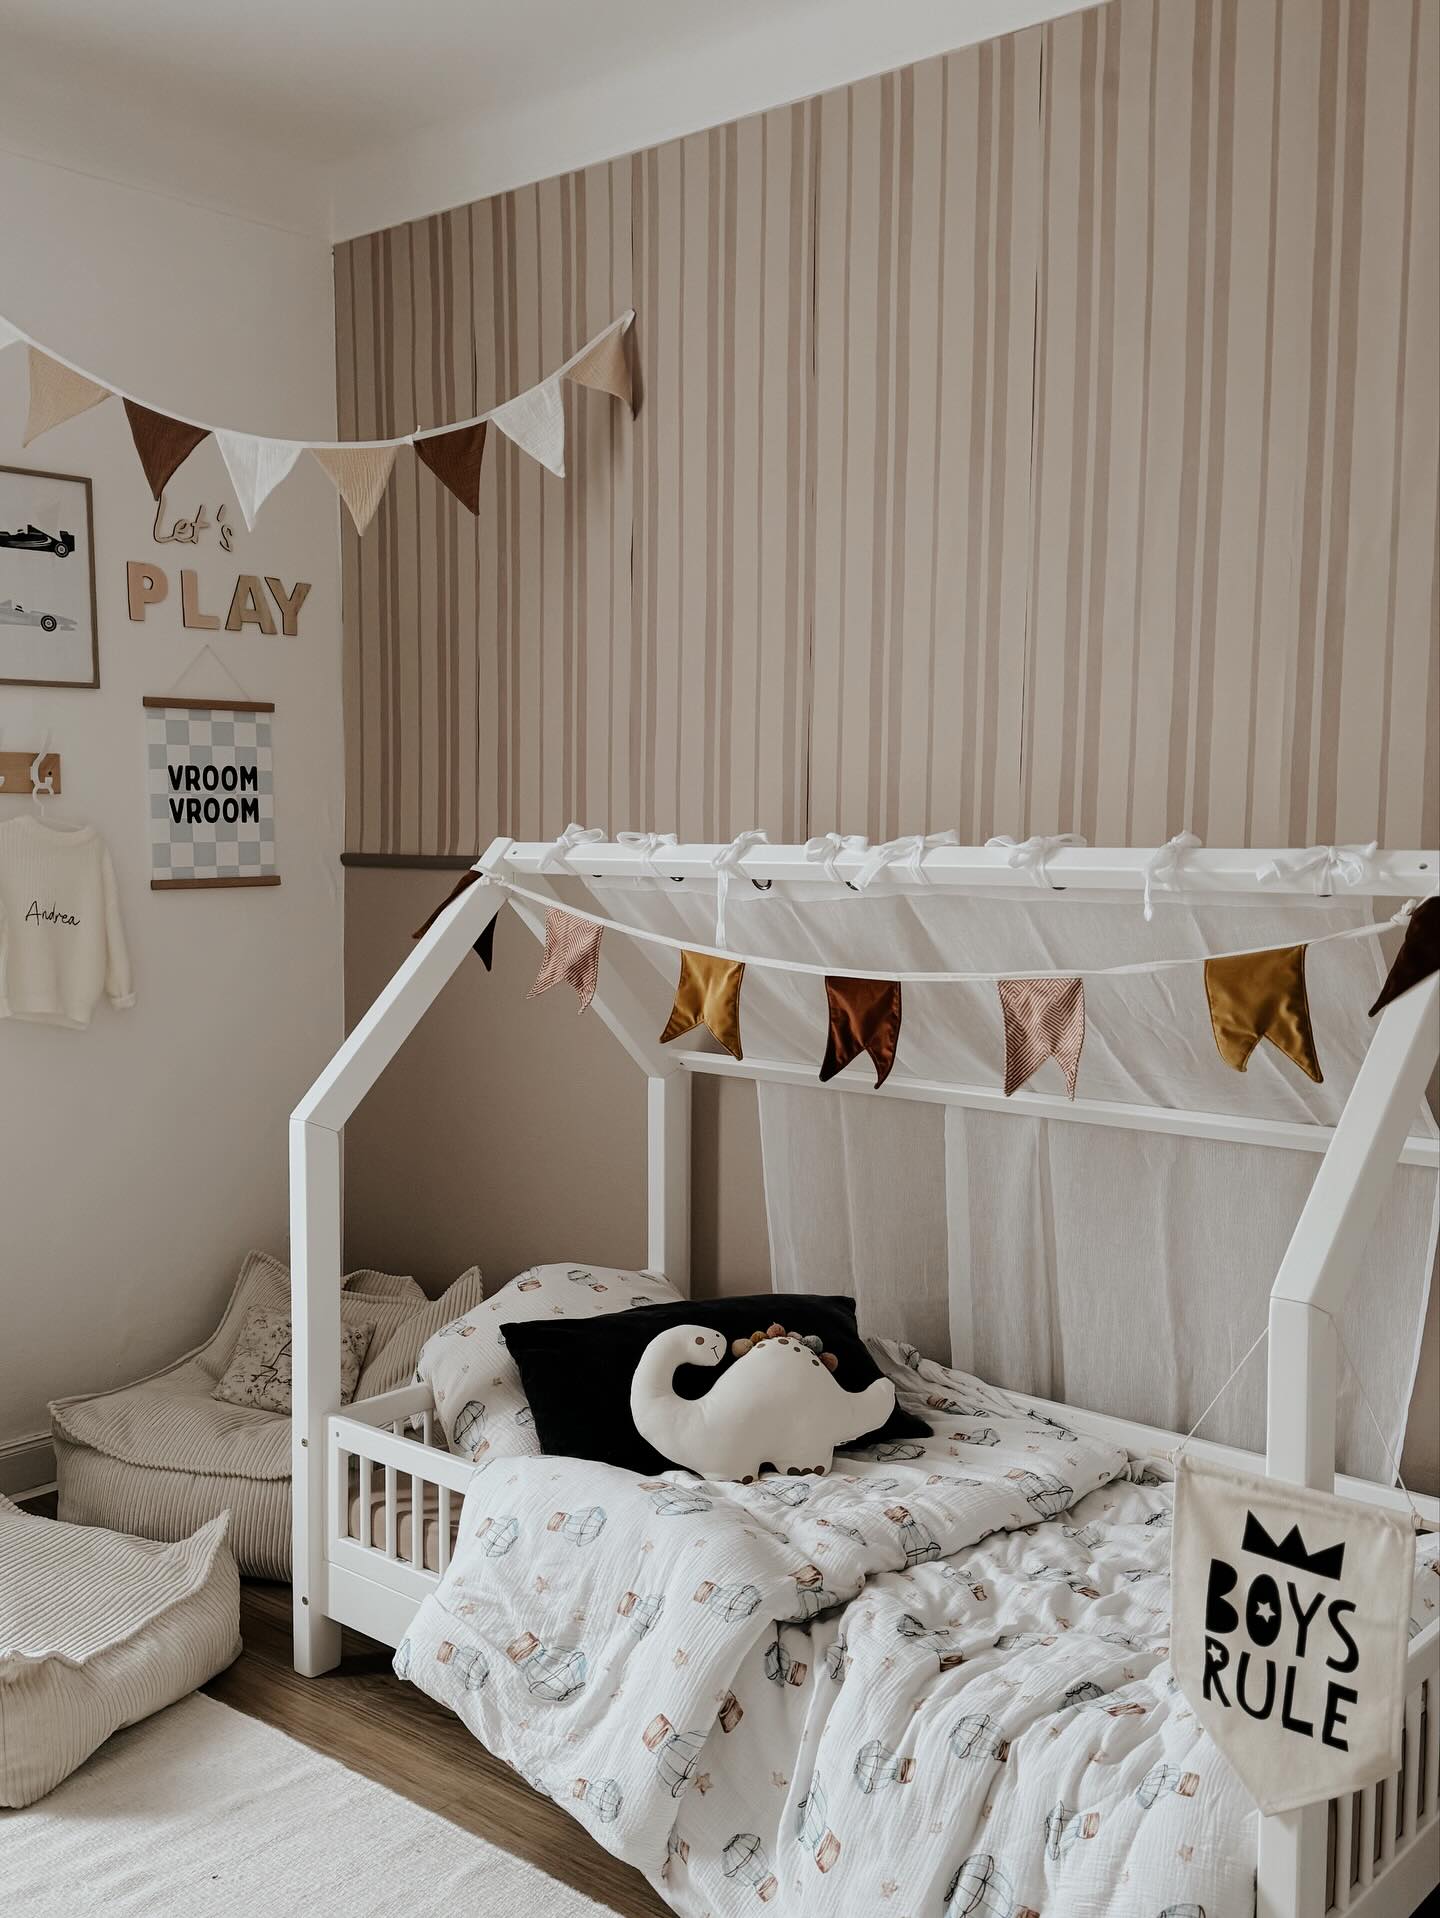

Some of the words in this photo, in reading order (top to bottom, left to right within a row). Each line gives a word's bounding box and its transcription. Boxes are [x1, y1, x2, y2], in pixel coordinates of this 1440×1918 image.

[153, 495, 234, 552] Let's
[126, 560, 312, 636] PLAY
[167, 764, 259, 792] VROOM
[169, 797, 260, 824] VROOM
[25, 900, 81, 926] Andrea
[1205, 1558, 1359, 1673] BOYS
[1203, 1635, 1358, 1752] RULE
